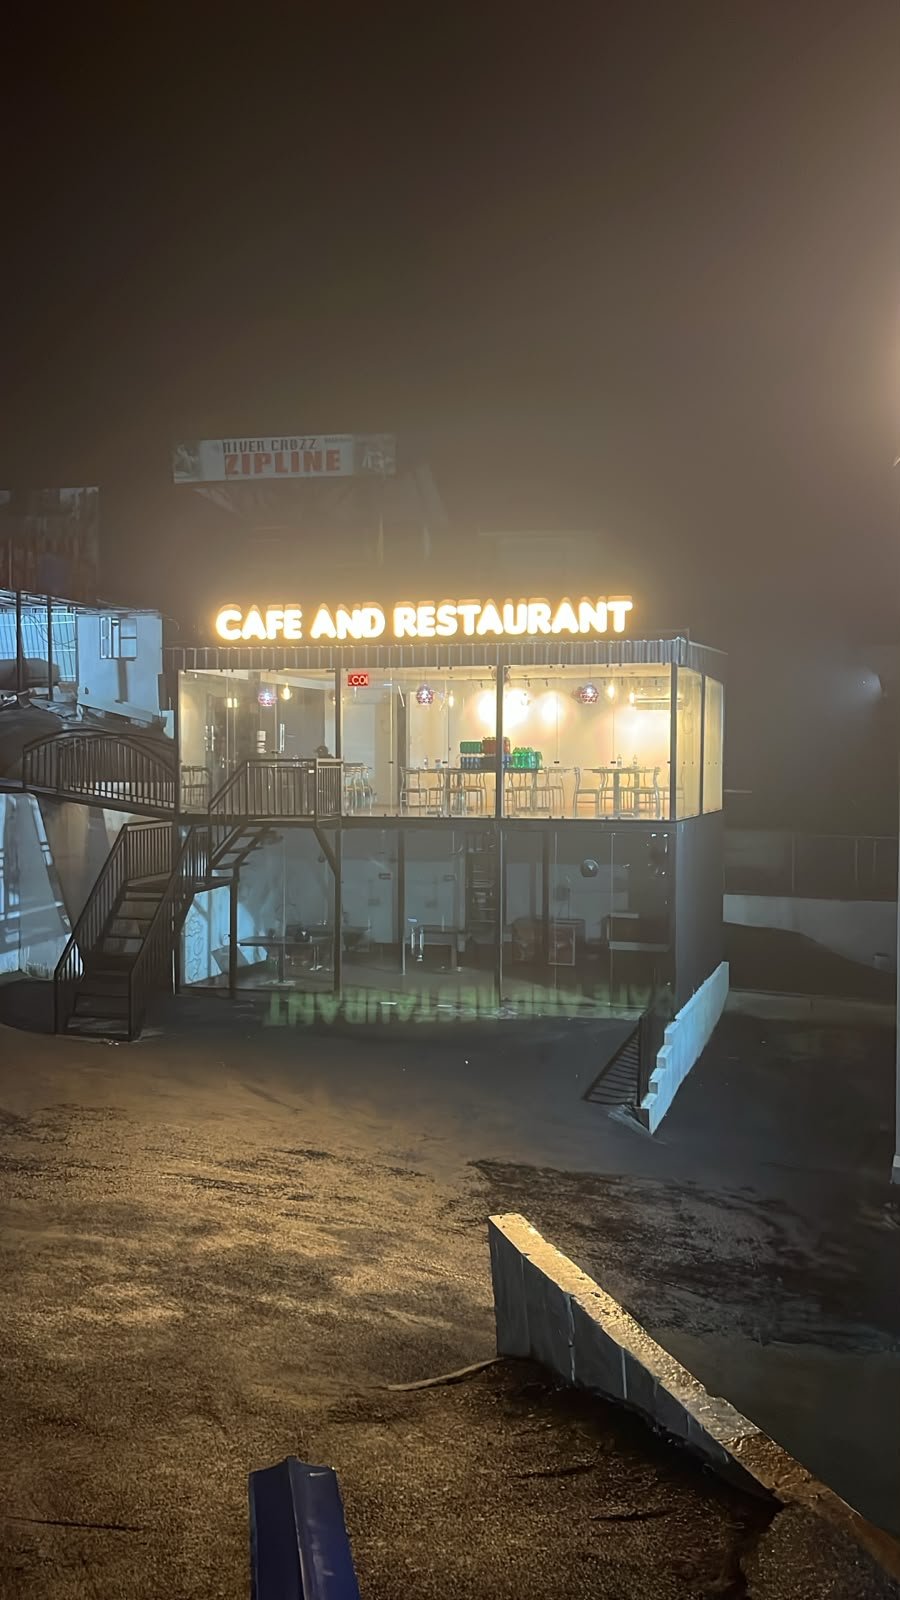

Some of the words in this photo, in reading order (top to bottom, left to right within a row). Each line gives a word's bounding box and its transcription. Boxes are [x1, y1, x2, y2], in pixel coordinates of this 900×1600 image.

[224, 449, 340, 475] ZIPLINE
[215, 604, 303, 640] CAFE
[310, 602, 386, 639] AND
[393, 596, 633, 637] RESTAURANT
